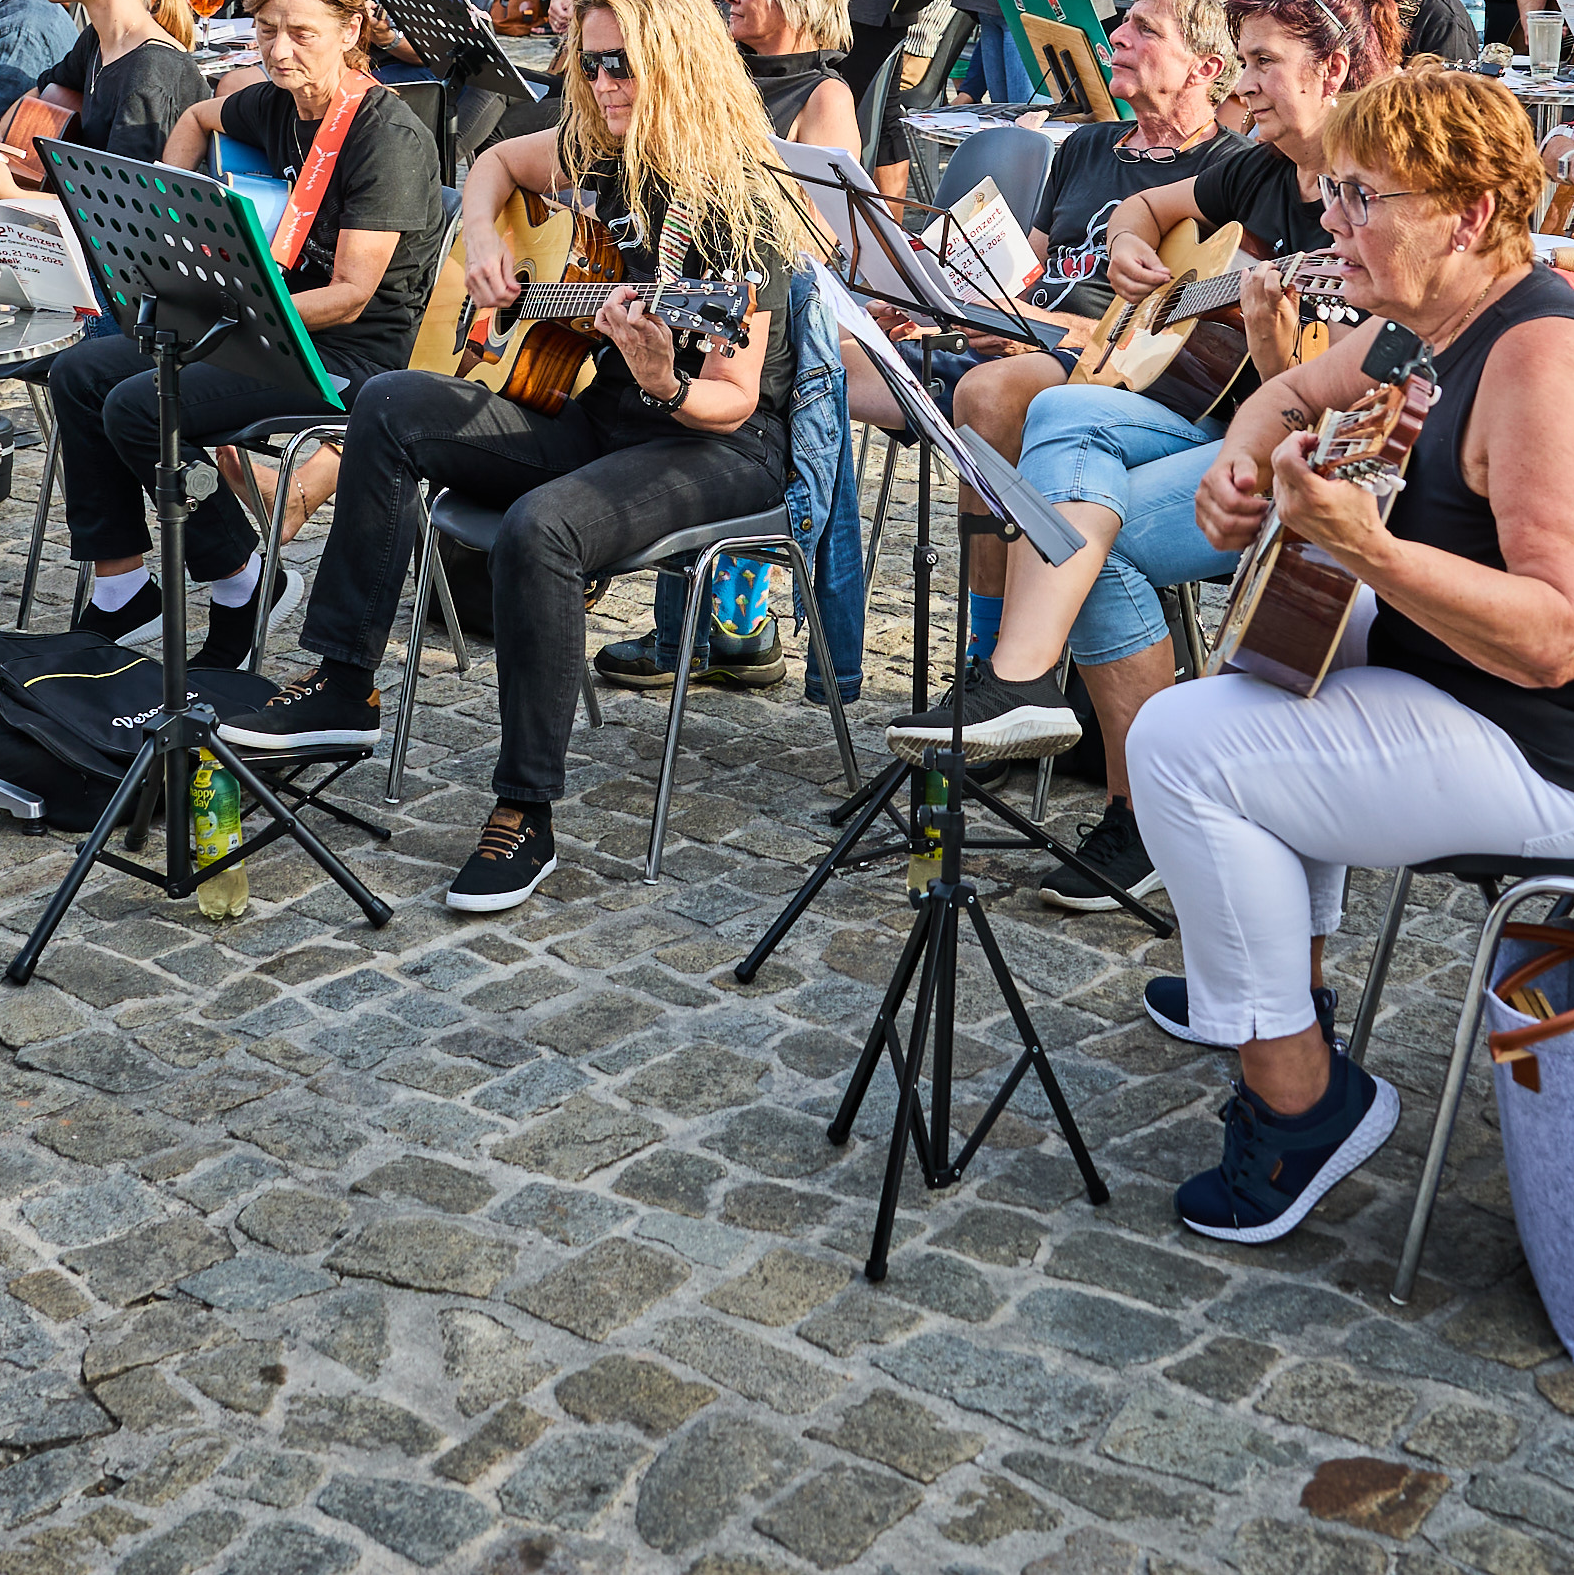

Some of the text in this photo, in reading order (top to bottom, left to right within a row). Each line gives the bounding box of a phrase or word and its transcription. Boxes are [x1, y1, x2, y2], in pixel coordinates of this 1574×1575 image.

[17, 231, 64, 251] Konzert
[190, 787, 216, 801] happy
[193, 795, 210, 810] day
